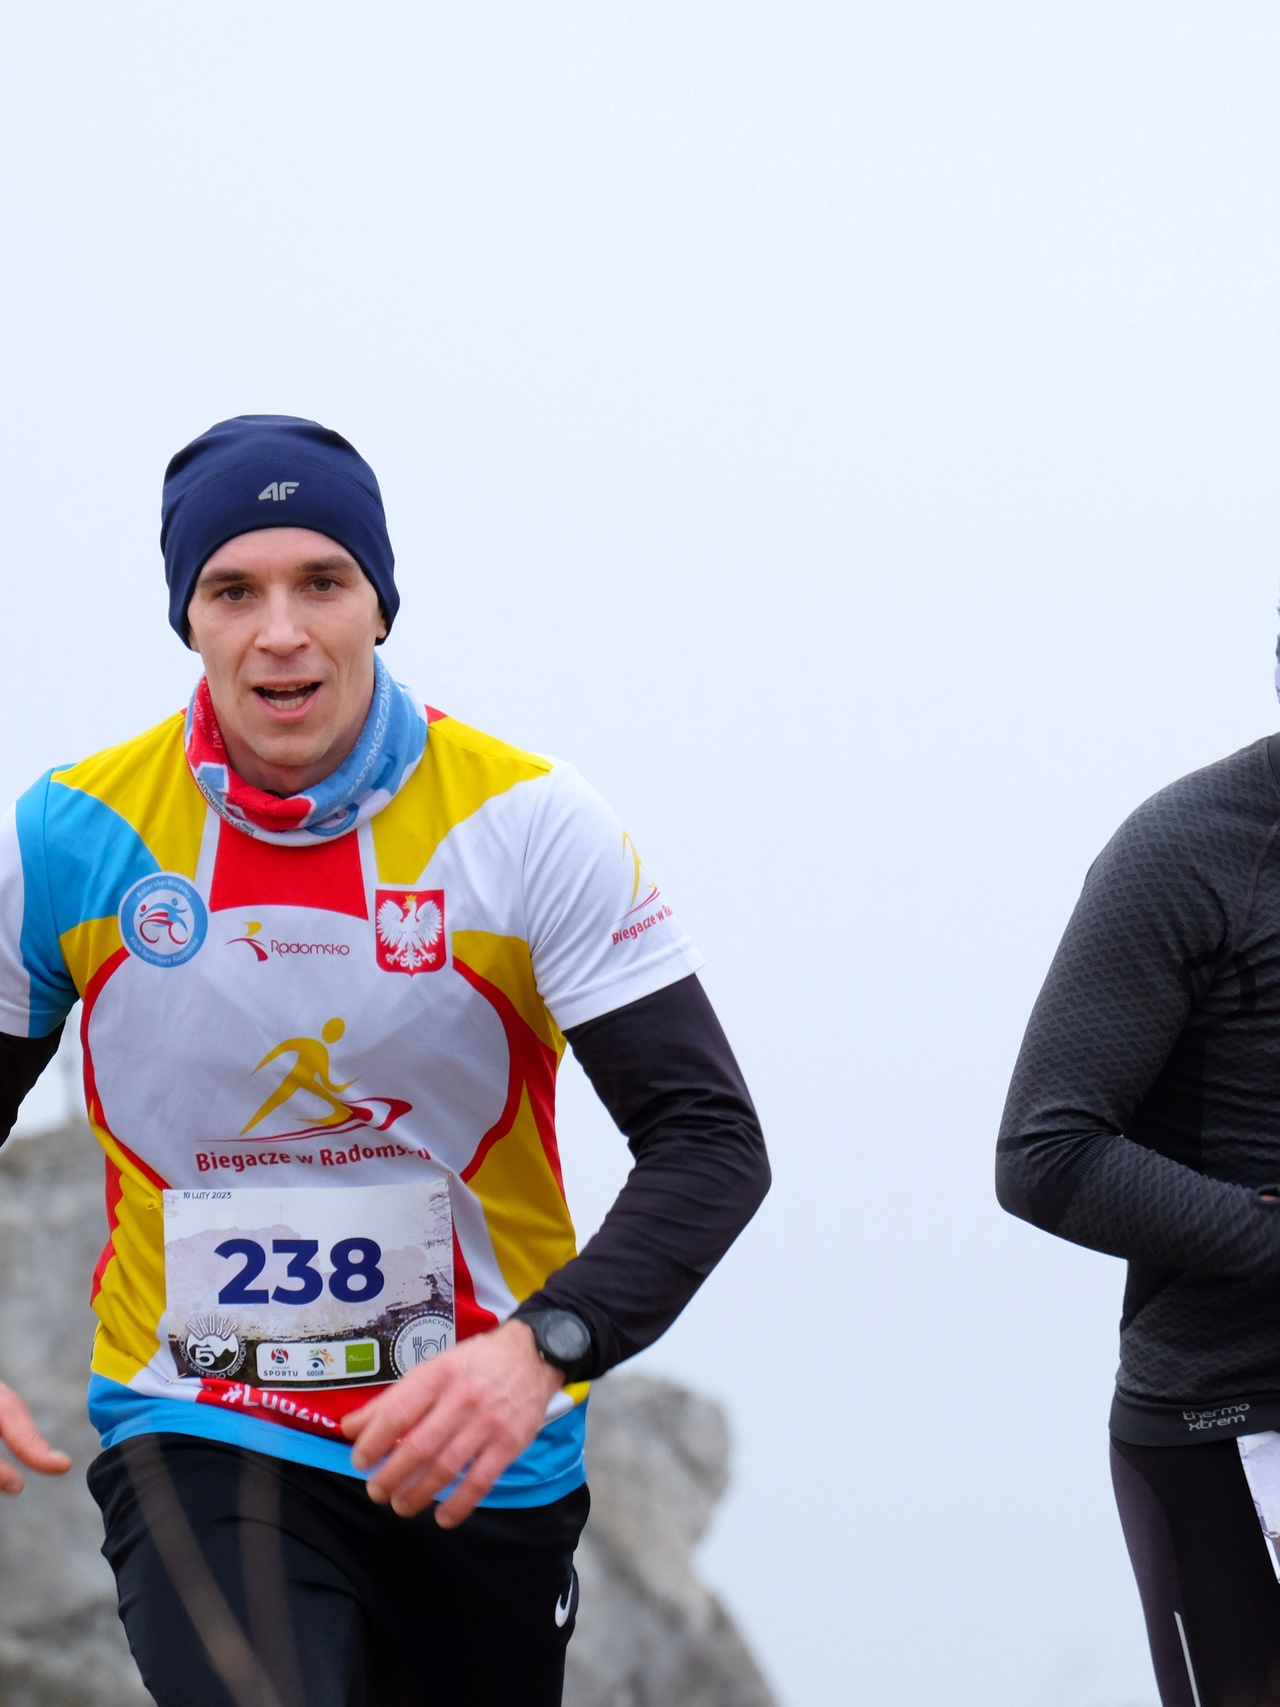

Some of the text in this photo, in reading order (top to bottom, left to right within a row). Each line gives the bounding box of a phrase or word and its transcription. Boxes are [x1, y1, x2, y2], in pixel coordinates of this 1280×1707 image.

[258, 481, 300, 501] 4F
[612, 915, 657, 946] Biegacze
[655, 910, 665, 921] w
[271, 939, 350, 958] Radomsko
[195, 1151, 291, 1173] Biegacze
[295, 1154, 314, 1165] w
[191, 1191, 210, 1200] LUTY
[211, 1191, 232, 1199] 2023
[214, 1237, 385, 1305] 238
[186, 1314, 238, 1339] CROSS
[400, 1318, 453, 1343] REGENERACYJNY
[194, 1346, 216, 1368] 5
[263, 1369, 299, 1378] SPORTU
[1182, 1403, 1251, 1421] thermo
[1188, 1414, 1246, 1431] xtrem
